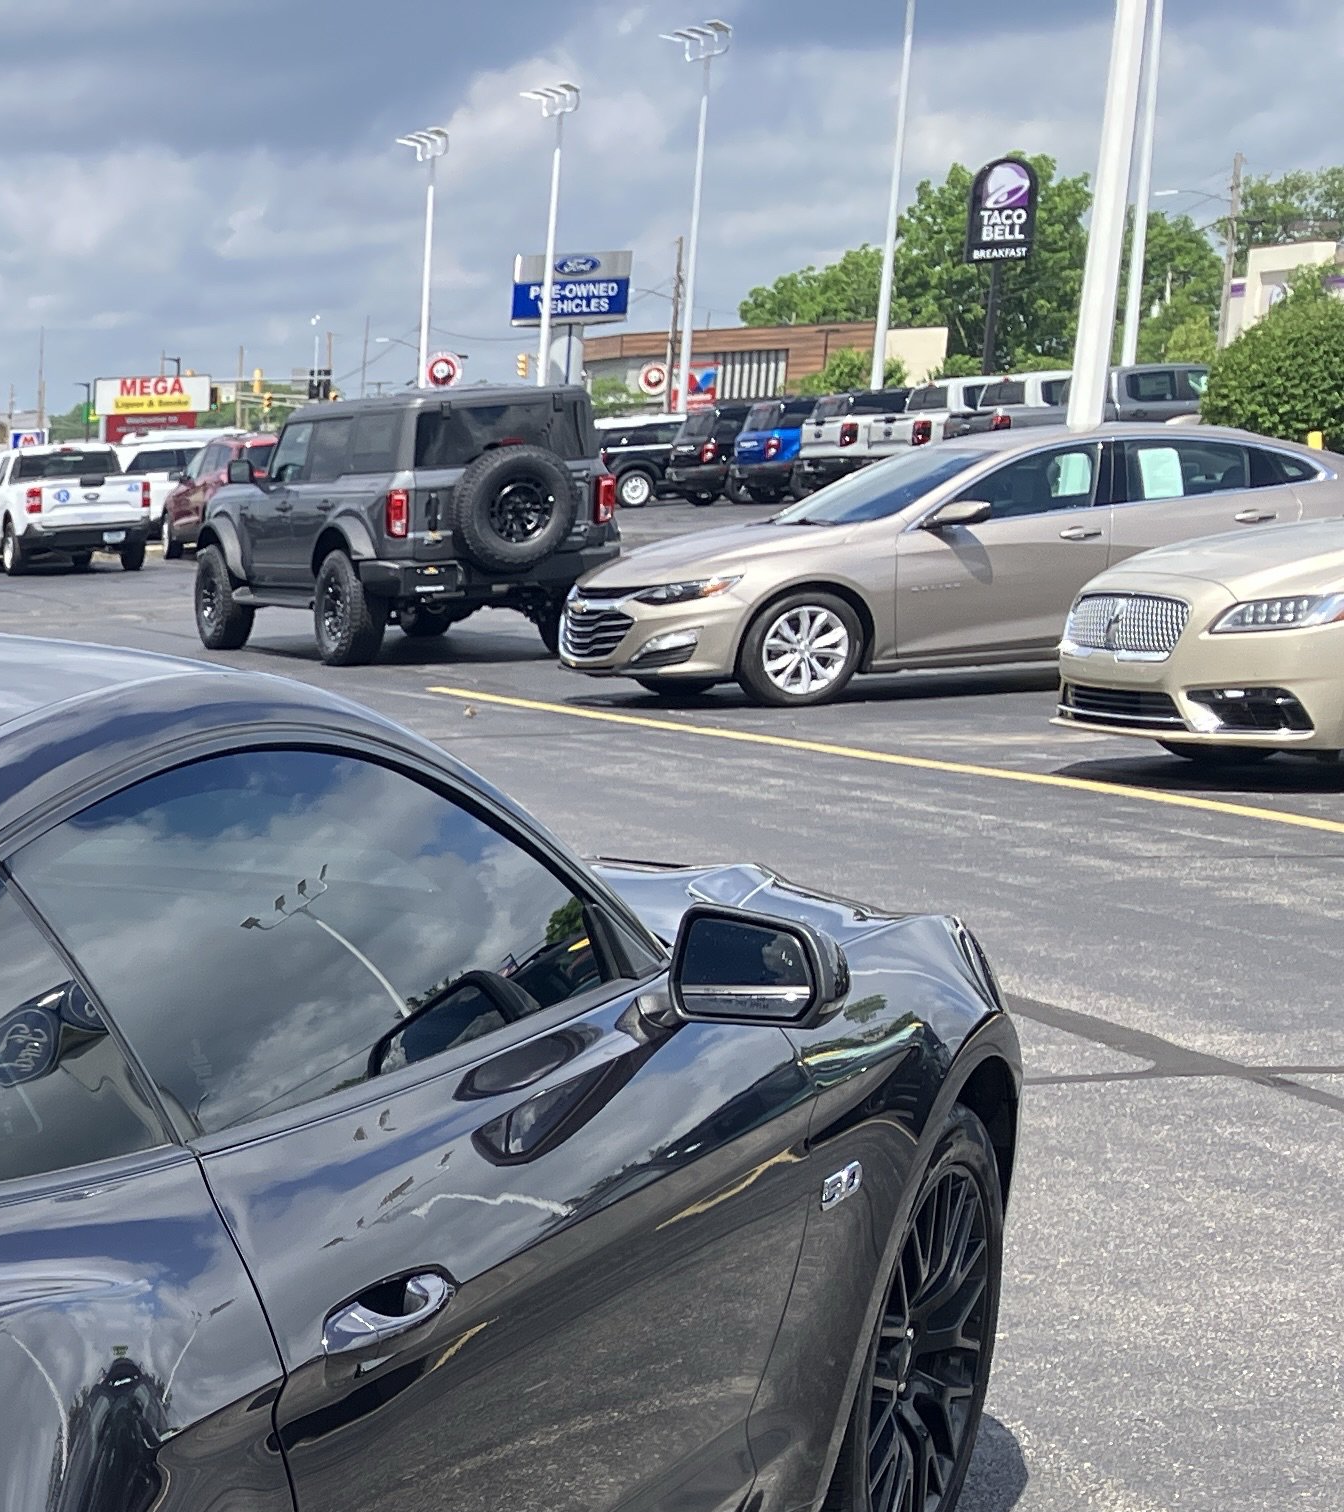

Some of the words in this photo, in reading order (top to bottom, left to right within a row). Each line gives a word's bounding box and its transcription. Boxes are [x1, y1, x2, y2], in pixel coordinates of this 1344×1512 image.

[980, 208, 1027, 225] TACO
[982, 225, 1025, 240] BELL
[973, 247, 1027, 260] BREAKFAST
[529, 282, 618, 299] PE-OWNED
[120, 376, 184, 396] MEGA
